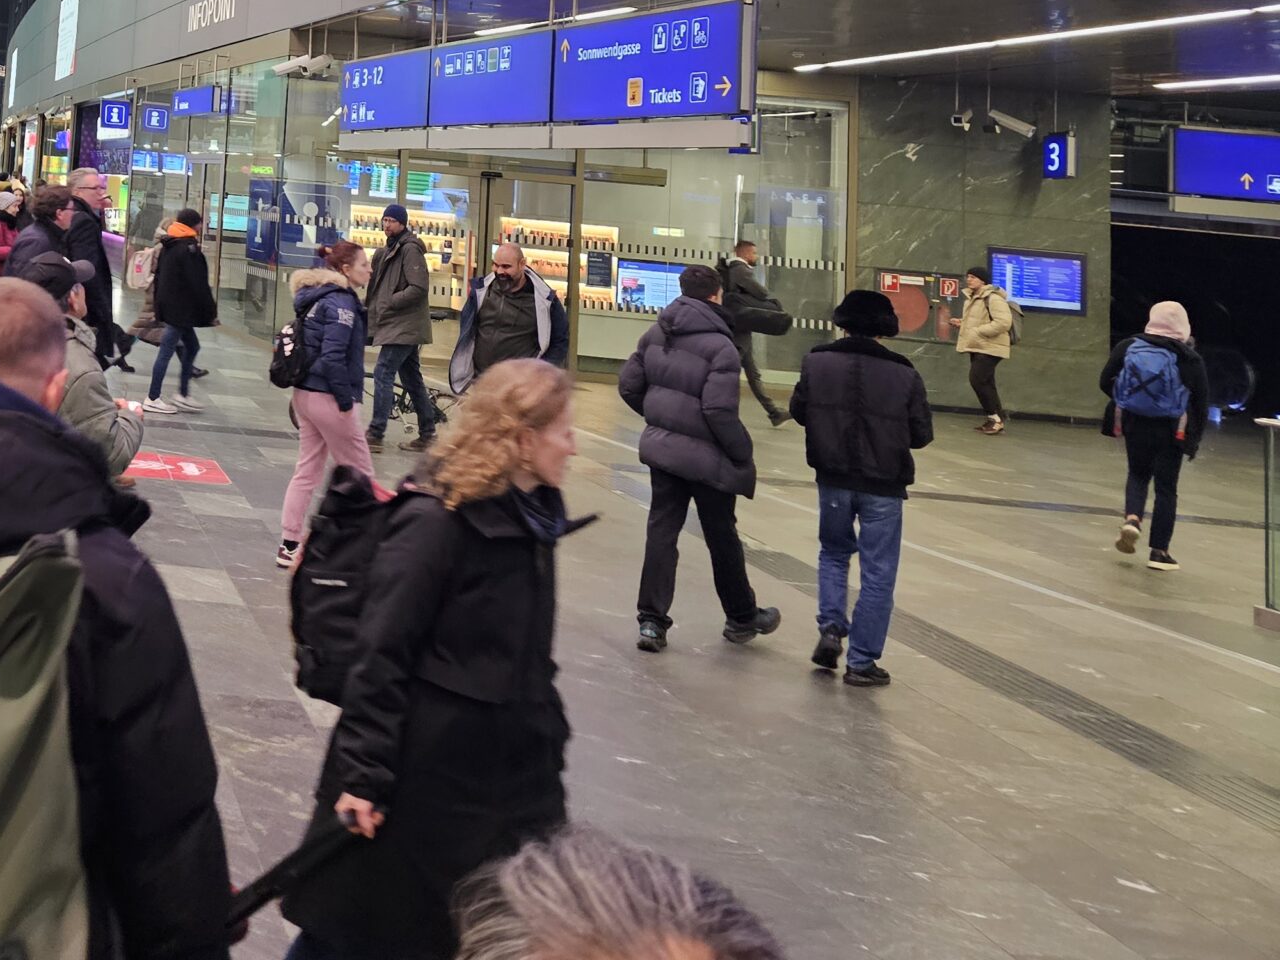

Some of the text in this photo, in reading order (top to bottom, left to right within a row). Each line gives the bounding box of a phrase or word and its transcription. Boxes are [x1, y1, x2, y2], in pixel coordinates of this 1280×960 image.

[578, 42, 641, 61] Sonnwendgasse
[649, 88, 682, 104] Tickets
[1047, 142, 1061, 172] 3
